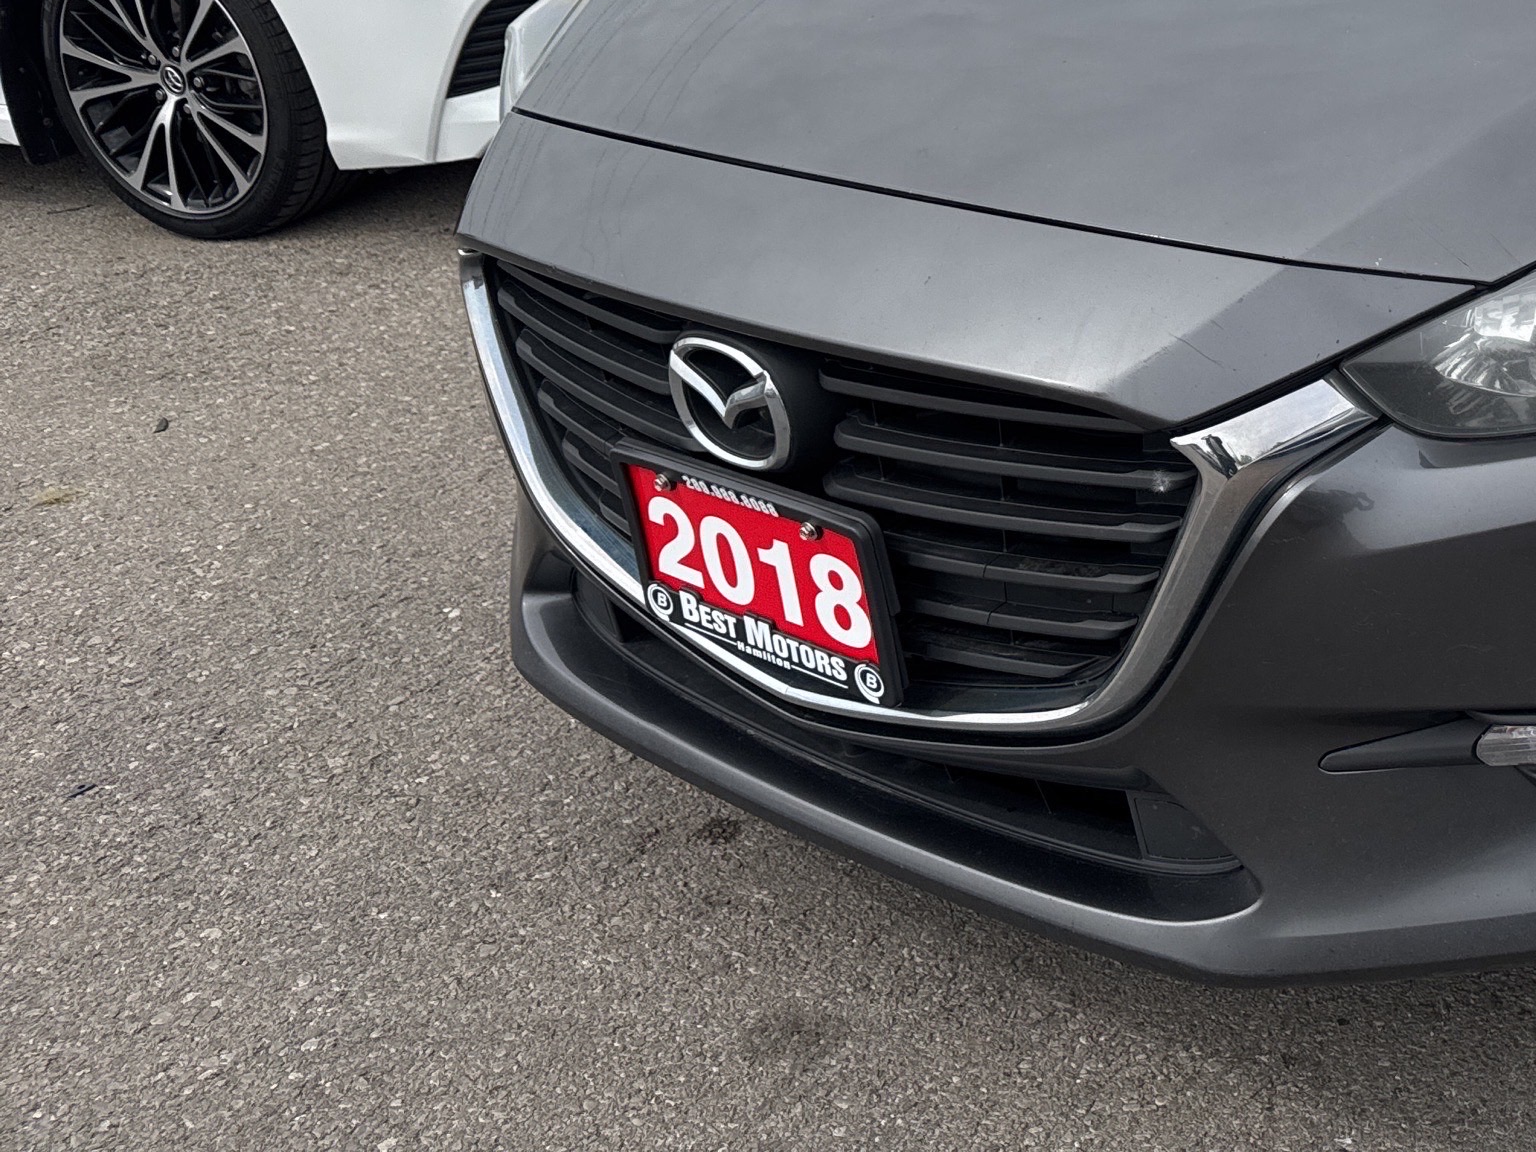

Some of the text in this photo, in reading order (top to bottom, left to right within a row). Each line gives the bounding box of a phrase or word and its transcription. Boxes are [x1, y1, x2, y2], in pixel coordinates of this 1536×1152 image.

[647, 495, 873, 649] 2018
[678, 590, 849, 682] BEST MOTORS
[737, 640, 792, 671] Hamilton
